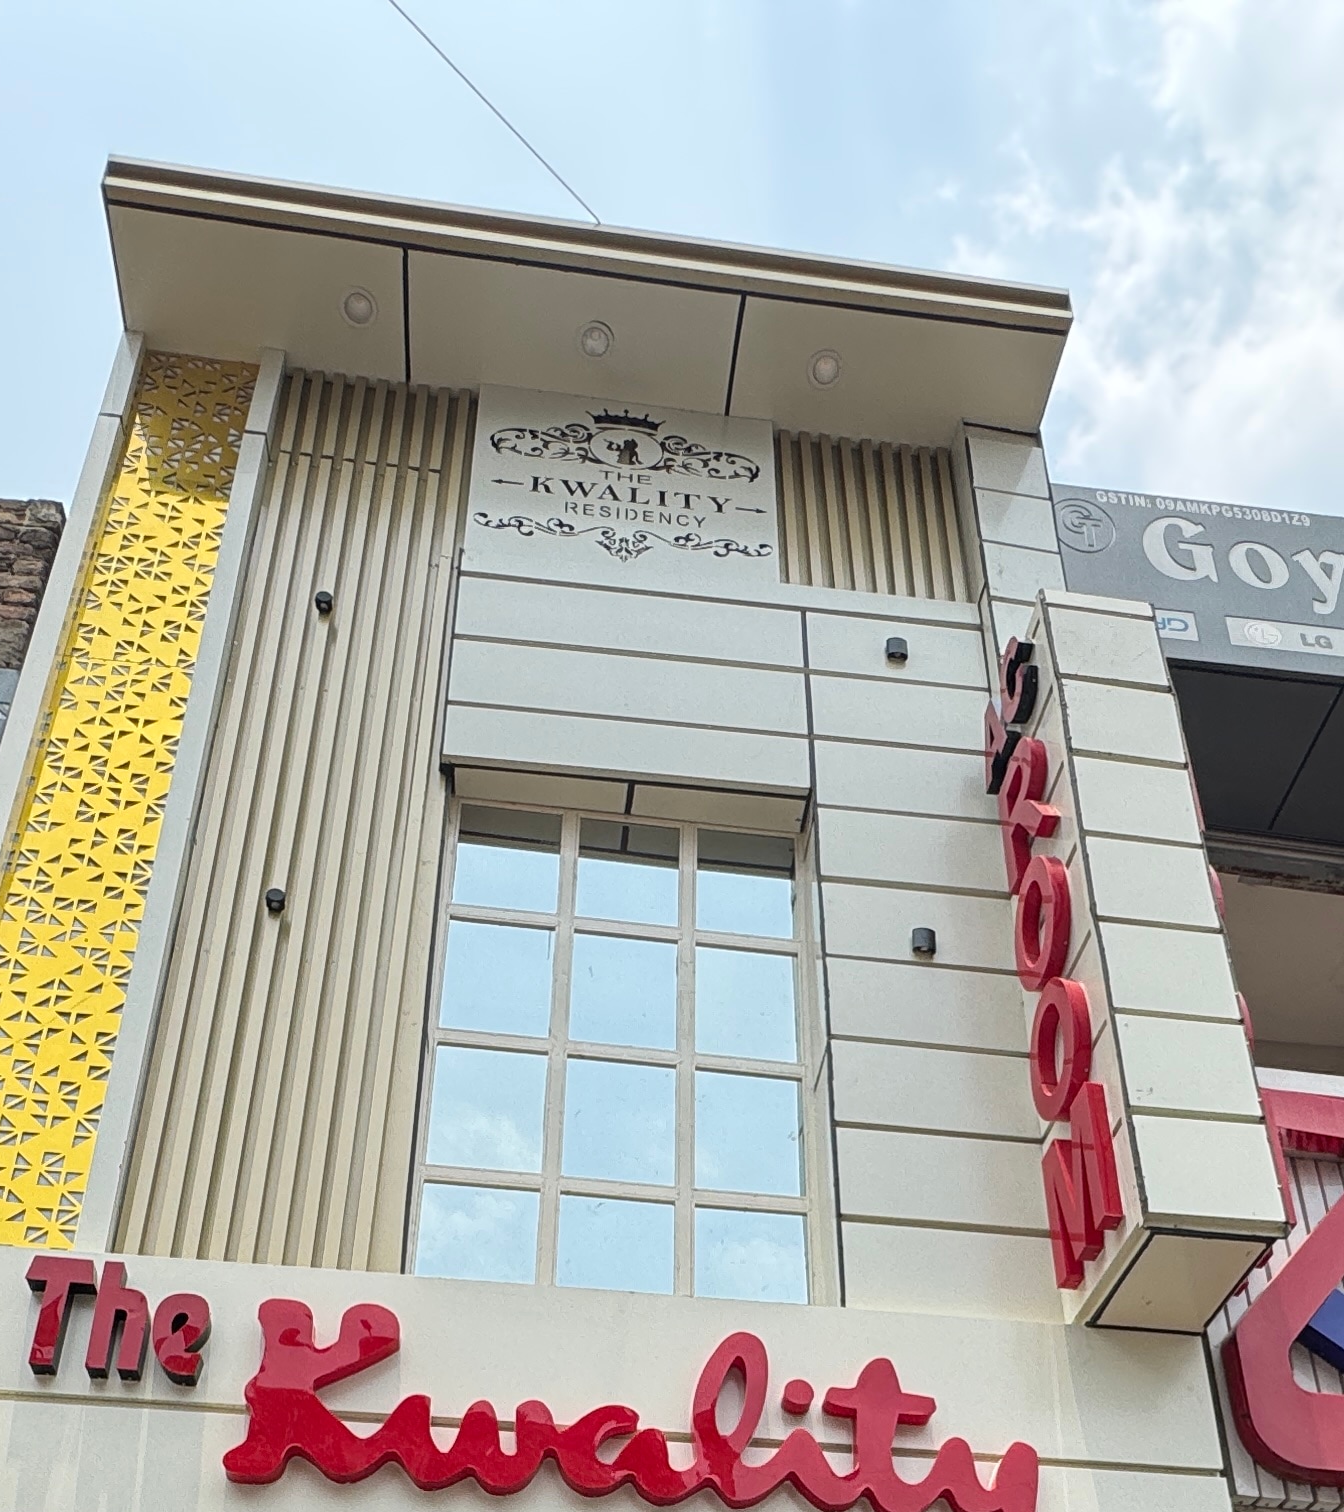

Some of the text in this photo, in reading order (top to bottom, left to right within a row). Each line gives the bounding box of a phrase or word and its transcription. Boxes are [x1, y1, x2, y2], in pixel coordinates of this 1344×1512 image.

[529, 474, 734, 515] KWALITY
[599, 469, 653, 486] THE
[564, 501, 707, 529] RESIDENCY
[1297, 630, 1335, 652] LG
[998, 735, 1124, 1290] ROOM
[26, 1254, 212, 1387] The
